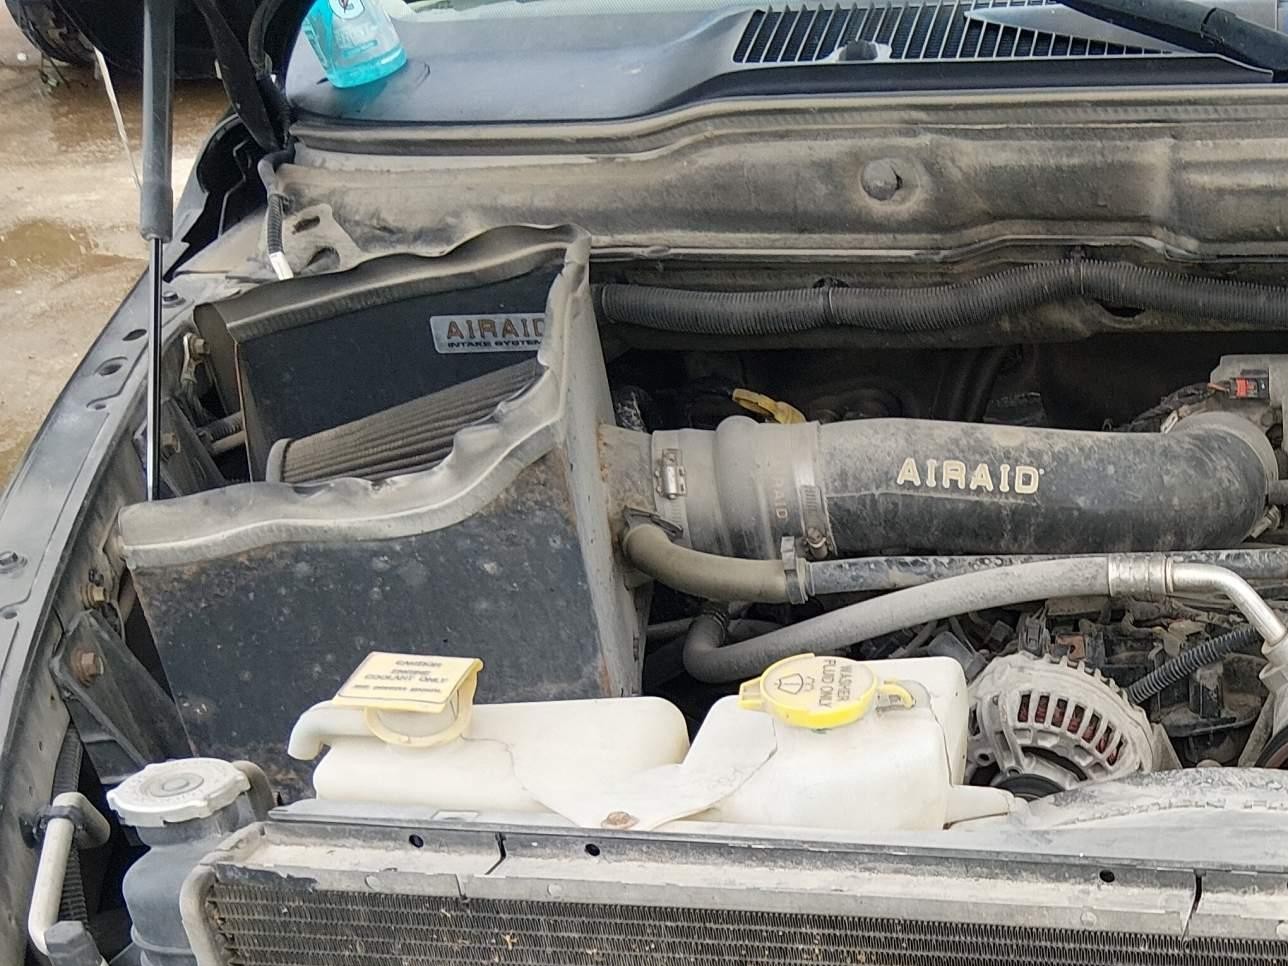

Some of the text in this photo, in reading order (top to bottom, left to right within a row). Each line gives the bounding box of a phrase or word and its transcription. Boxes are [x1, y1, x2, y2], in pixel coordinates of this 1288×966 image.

[447, 318, 545, 340] AIRAID
[448, 340, 492, 348] INTAKE
[896, 456, 1040, 495] AIRAID
[819, 661, 836, 707] FLUID ONLY
[838, 666, 852, 701] WASHER
